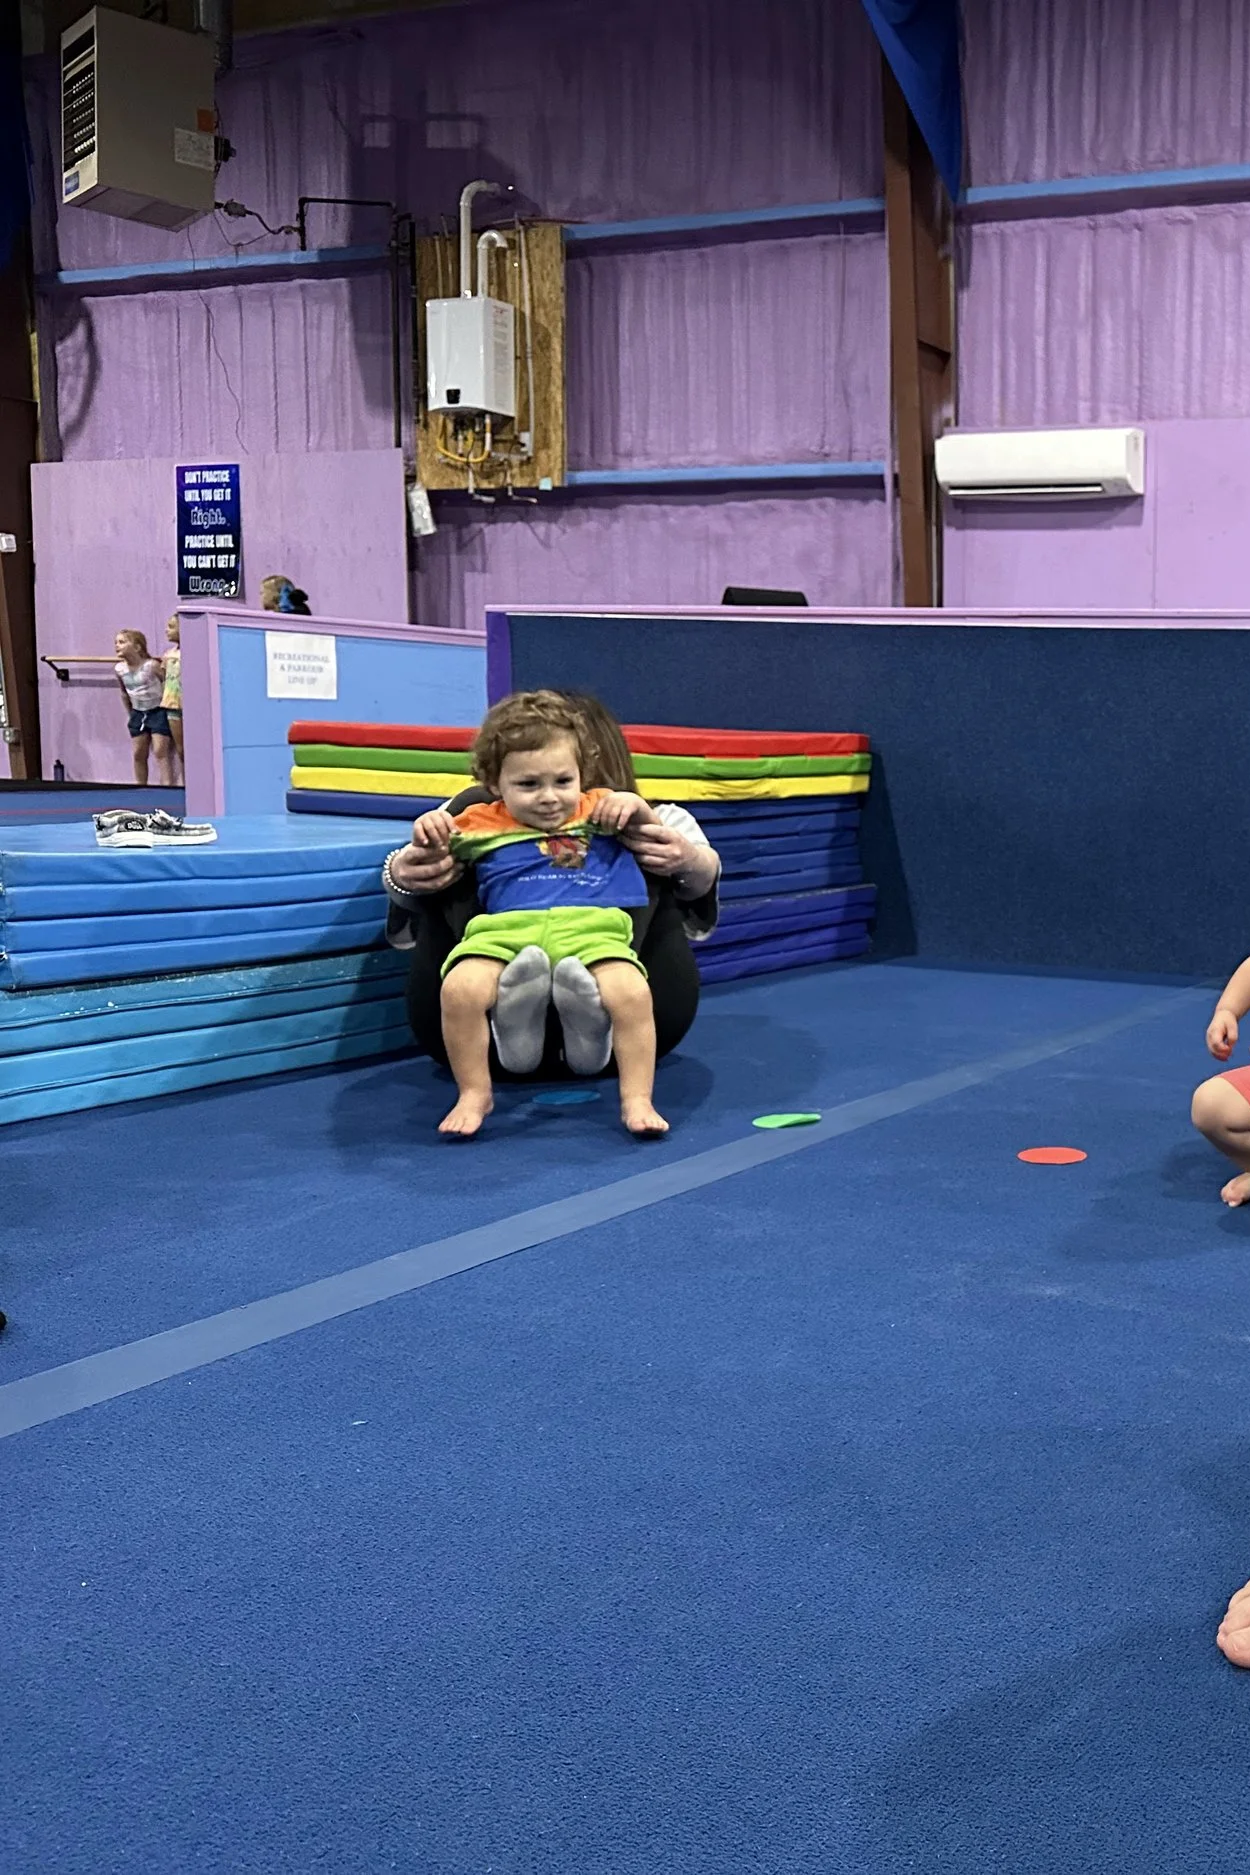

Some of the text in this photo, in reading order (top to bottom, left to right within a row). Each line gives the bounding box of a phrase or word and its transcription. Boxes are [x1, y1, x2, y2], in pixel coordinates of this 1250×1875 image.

[185, 470, 230, 483] DON'T PRACTICE
[184, 488, 231, 502] UNTIL YOU GET IT
[185, 534, 234, 548] PRACTICE UNTIL
[183, 554, 236, 568] YOU CAN'T GET IT
[273, 652, 330, 662] RECREATIONAL
